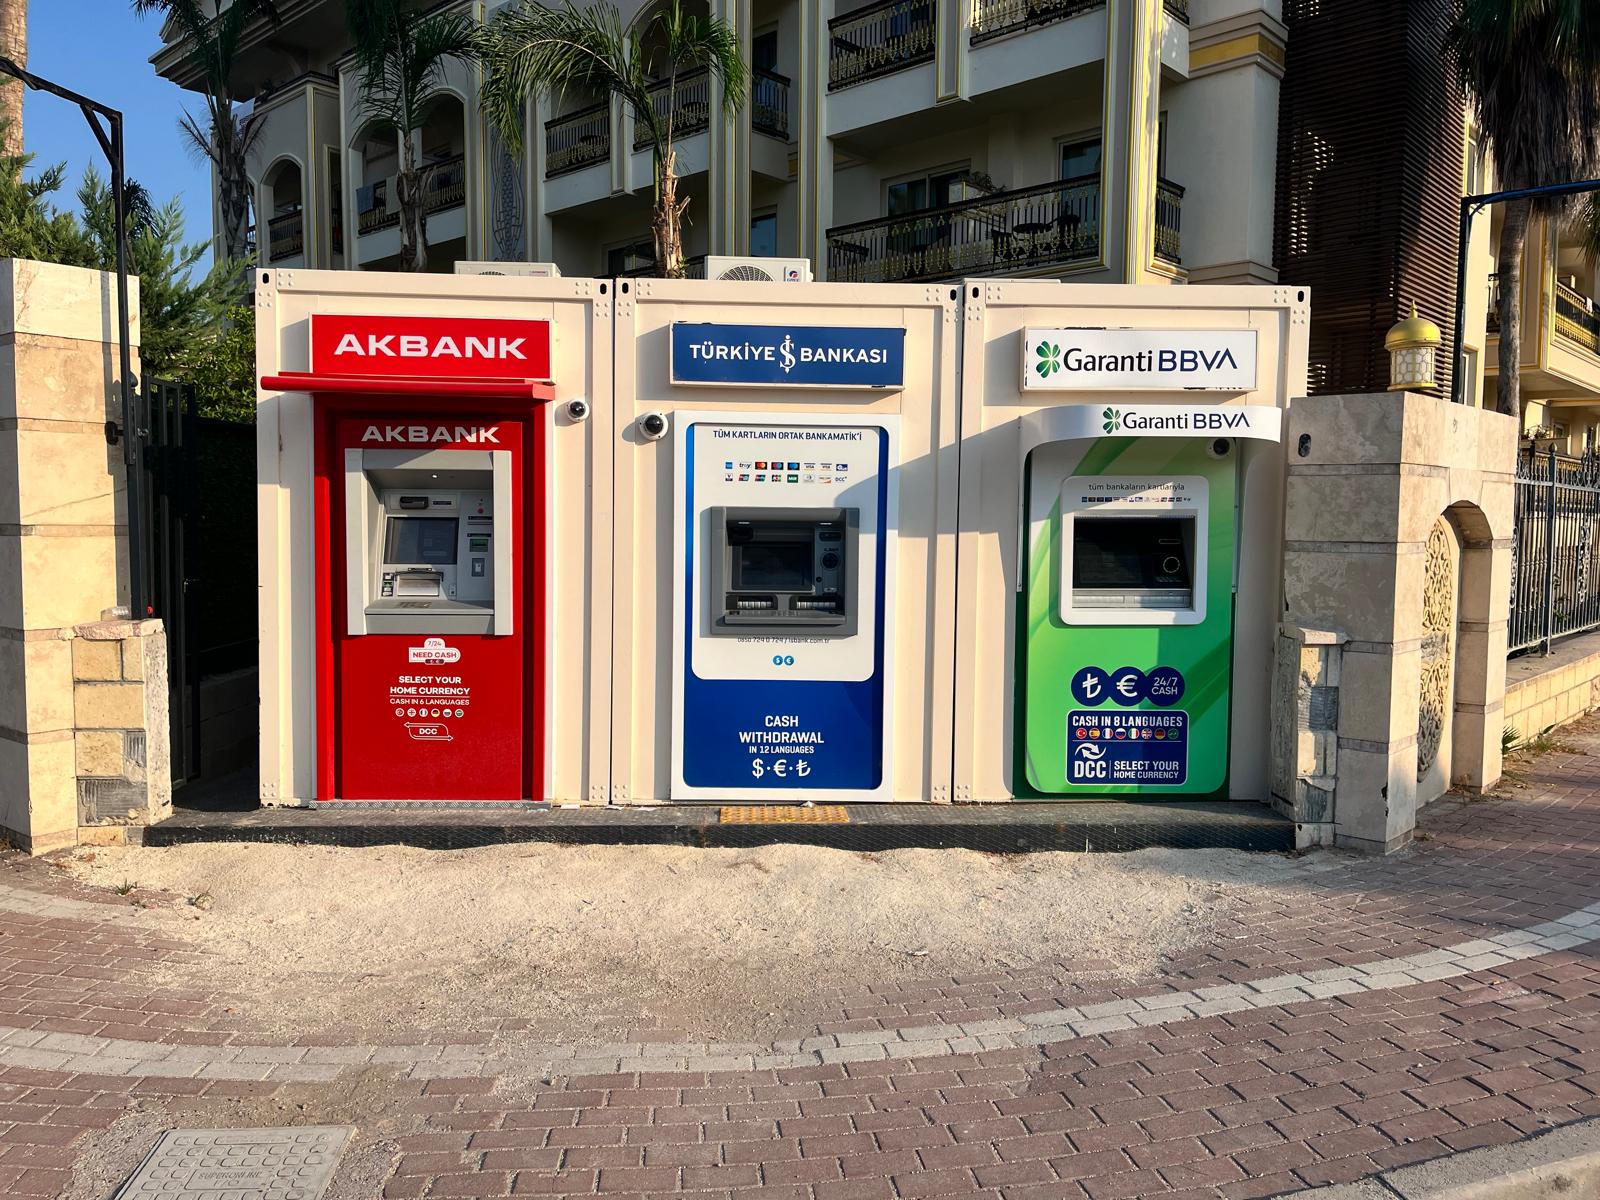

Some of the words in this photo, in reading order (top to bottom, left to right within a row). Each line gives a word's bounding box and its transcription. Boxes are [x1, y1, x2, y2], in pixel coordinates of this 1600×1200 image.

[334, 334, 527, 360] AKBANK
[689, 340, 776, 361] TÜRKİYE
[800, 347, 887, 364] BANKASI
[1063, 347, 1153, 372] Garanti
[1158, 348, 1238, 372] BBVA
[1123, 411, 1189, 430] Garanti
[1193, 412, 1251, 430] BBVA
[361, 425, 500, 443] AKBANK
[713, 429, 731, 439] TÜM
[732, 431, 777, 440] KARTLARIN
[779, 432, 804, 440] ORTAK
[1148, 483, 1185, 492] kartlarıyla
[399, 676, 433, 684] SELECT
[435, 676, 462, 684] YOUR
[1154, 677, 1177, 687] 24/7
[390, 686, 417, 694] HOME
[419, 687, 470, 695] CURRENCY
[1152, 687, 1178, 695] CASH
[765, 716, 799, 727] CASH
[1072, 716, 1098, 727] CASH
[1101, 716, 1111, 727] IN
[1114, 716, 1120, 727] 8
[1122, 716, 1183, 727] LANGUAGES
[419, 728, 437, 736] DCC
[739, 732, 824, 744] WITHDRAWAL
[749, 745, 757, 754] IN
[760, 746, 769, 754] 12
[771, 746, 814, 754] LANGUAGES
[1074, 761, 1106, 778] DCC
[1114, 761, 1149, 770] SELECT
[1153, 761, 1179, 770] YOUR
[1114, 771, 1136, 779] HOME
[1137, 771, 1179, 779] CURRENCY
